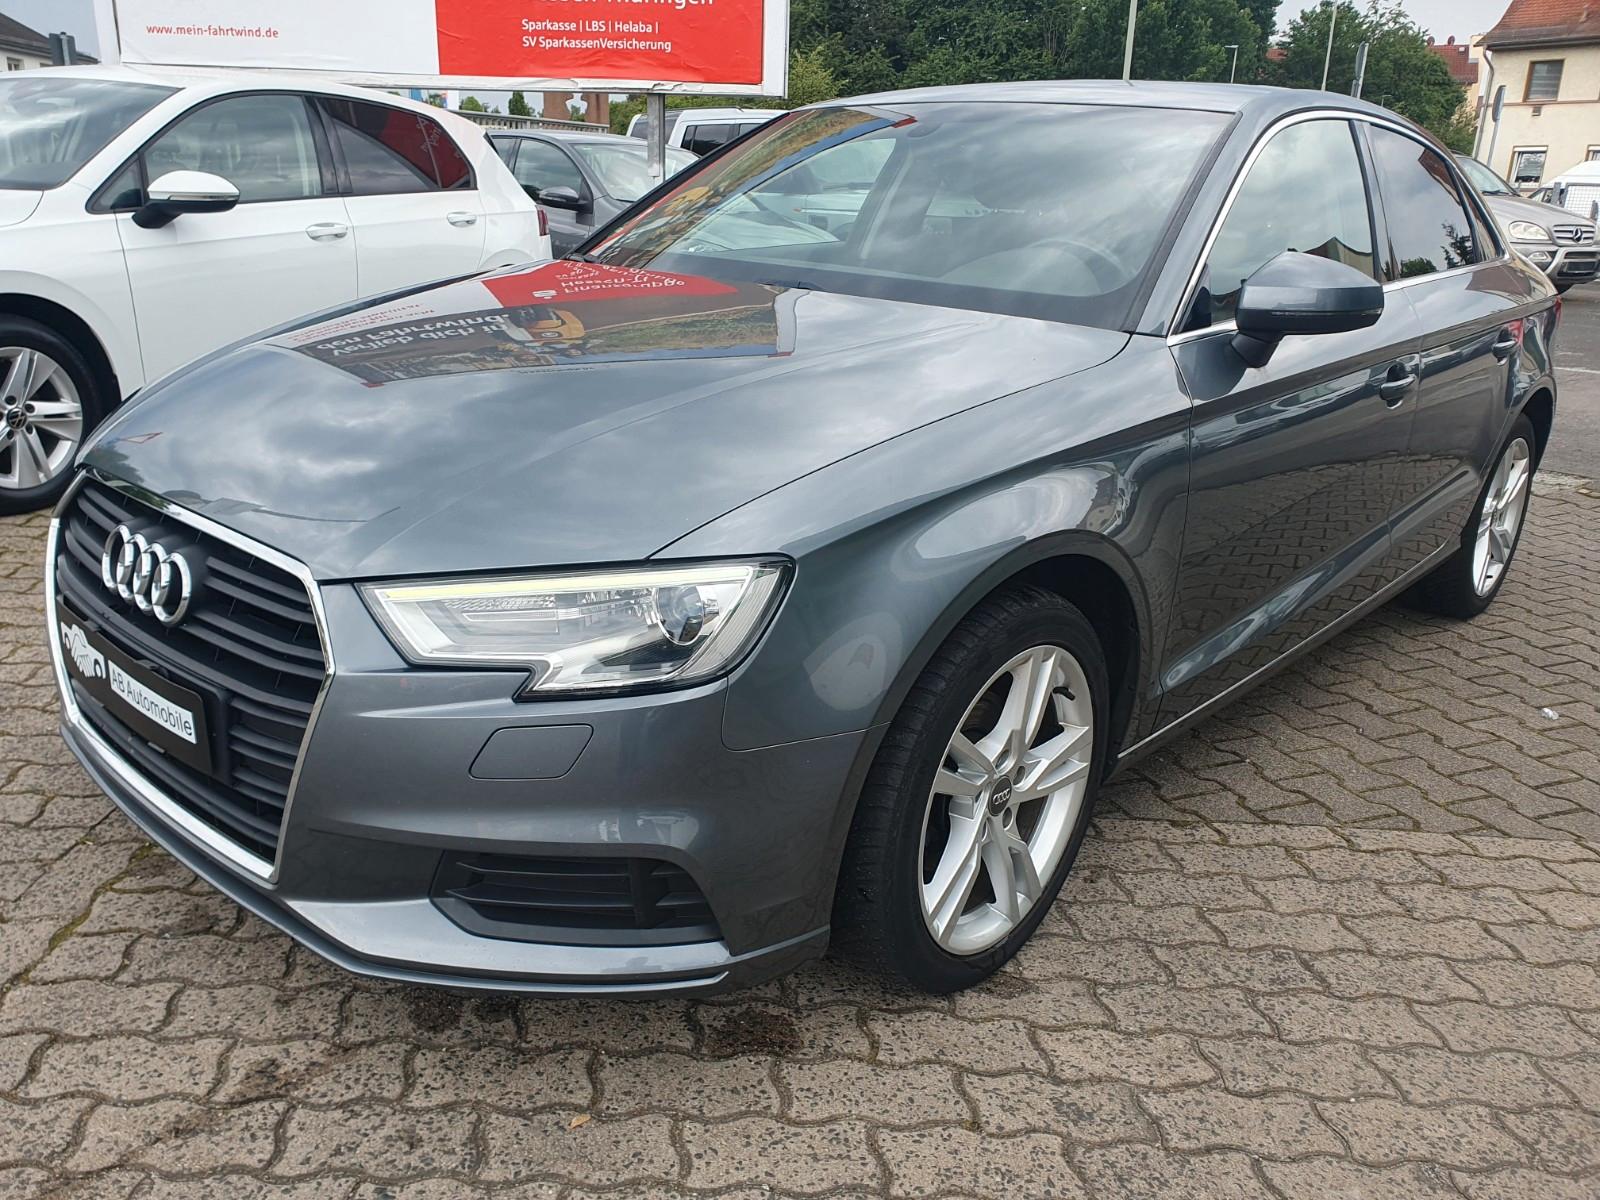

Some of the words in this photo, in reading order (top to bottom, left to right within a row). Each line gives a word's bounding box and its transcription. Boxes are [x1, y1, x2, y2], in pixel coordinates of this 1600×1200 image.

[146, 25, 279, 38] www.mein-fahrtwind.de
[522, 19, 577, 32] Sparkasse
[585, 20, 606, 32] LBS
[614, 21, 653, 33] Helaba
[522, 36, 537, 48] SV
[538, 37, 672, 52] SparkassenVersicherung
[112, 668, 126, 694] AB
[127, 680, 193, 737] Automobile
